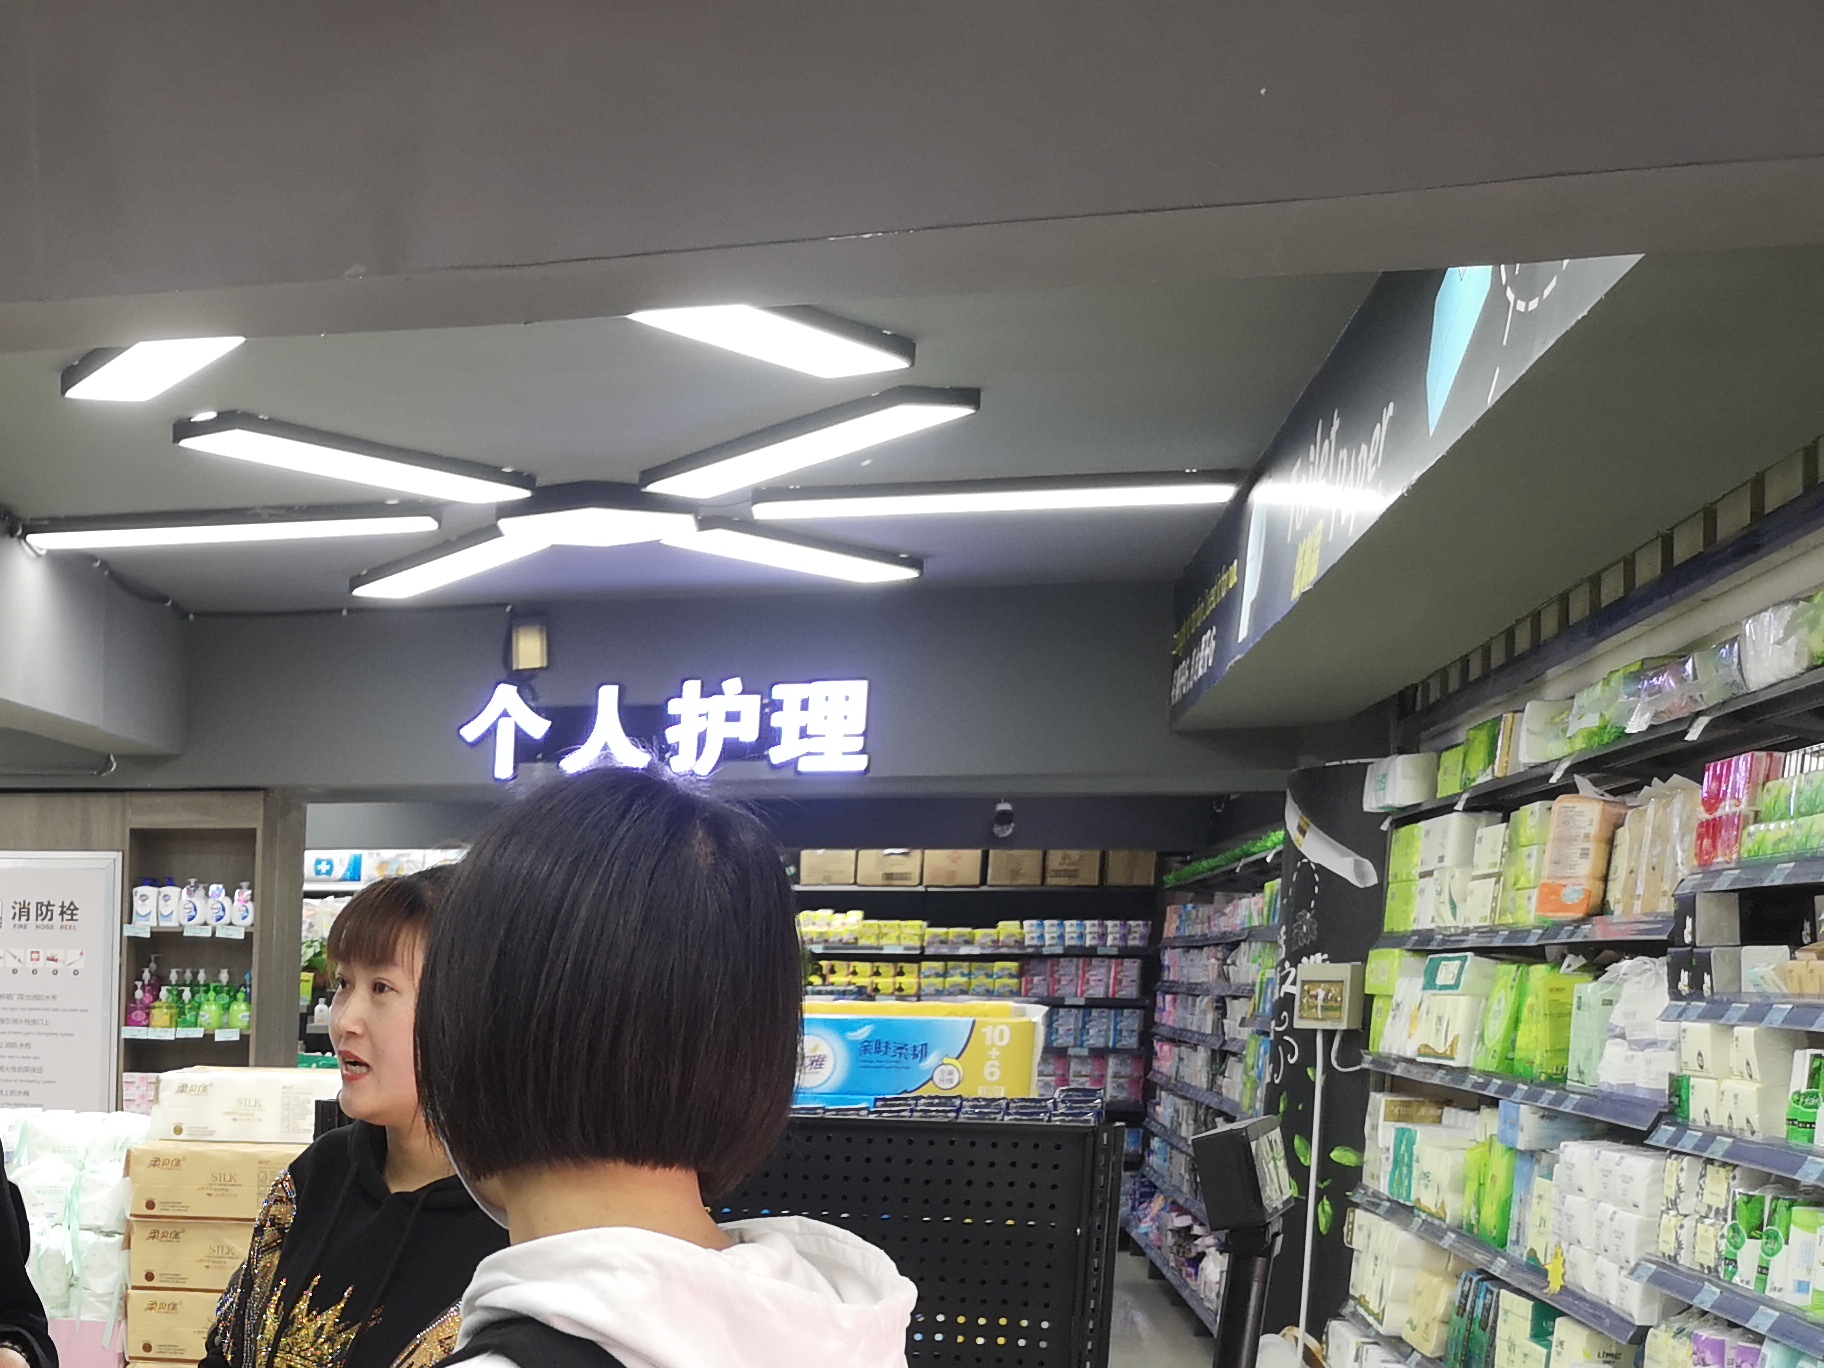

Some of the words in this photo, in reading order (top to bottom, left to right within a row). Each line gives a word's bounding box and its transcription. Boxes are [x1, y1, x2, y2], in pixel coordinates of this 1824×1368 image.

[457, 676, 871, 781] 个人护理
[10, 899, 80, 923] 消防栓
[981, 1024, 1011, 1047] 10
[983, 1059, 1002, 1082] 6
[236, 1097, 263, 1109] SILK
[210, 1171, 238, 1183] SILK
[208, 1244, 235, 1256] SILK
